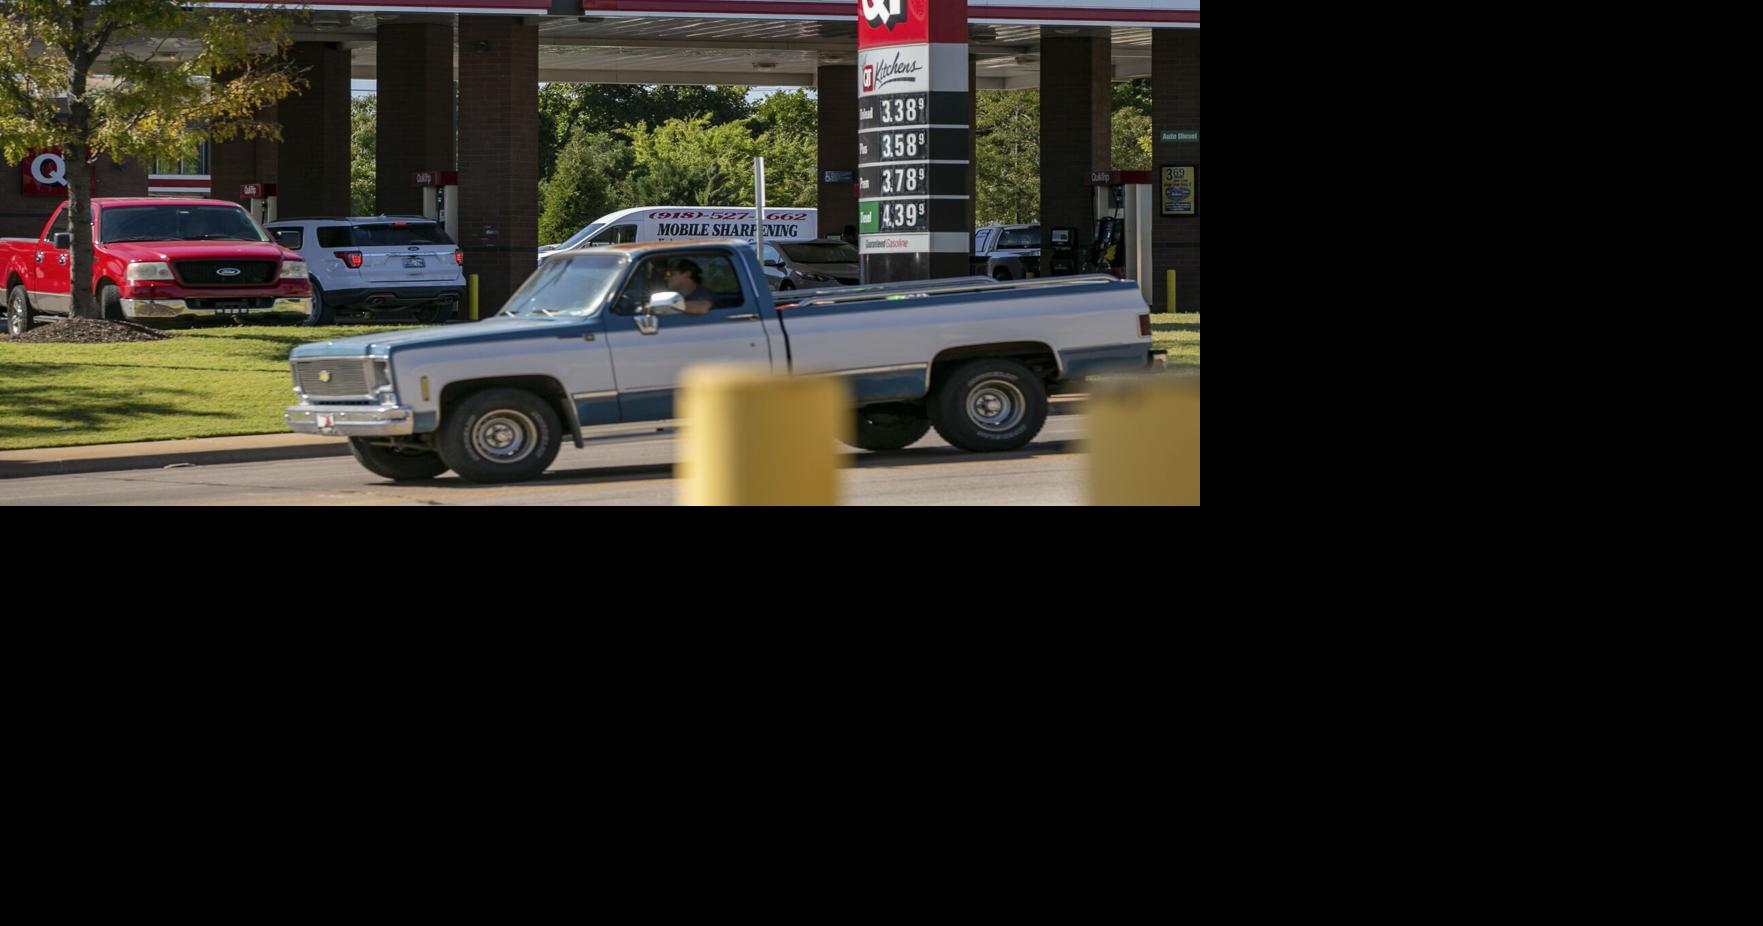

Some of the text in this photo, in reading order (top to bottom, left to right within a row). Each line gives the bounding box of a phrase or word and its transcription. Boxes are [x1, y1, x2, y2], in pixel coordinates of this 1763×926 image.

[875, 51, 922, 82] Kitchens
[1162, 132, 1198, 140] Auto Diesel
[31, 153, 68, 186] Q
[649, 211, 807, 221] (918)-527-662
[657, 223, 798, 237] MOBILE SHARPENING
